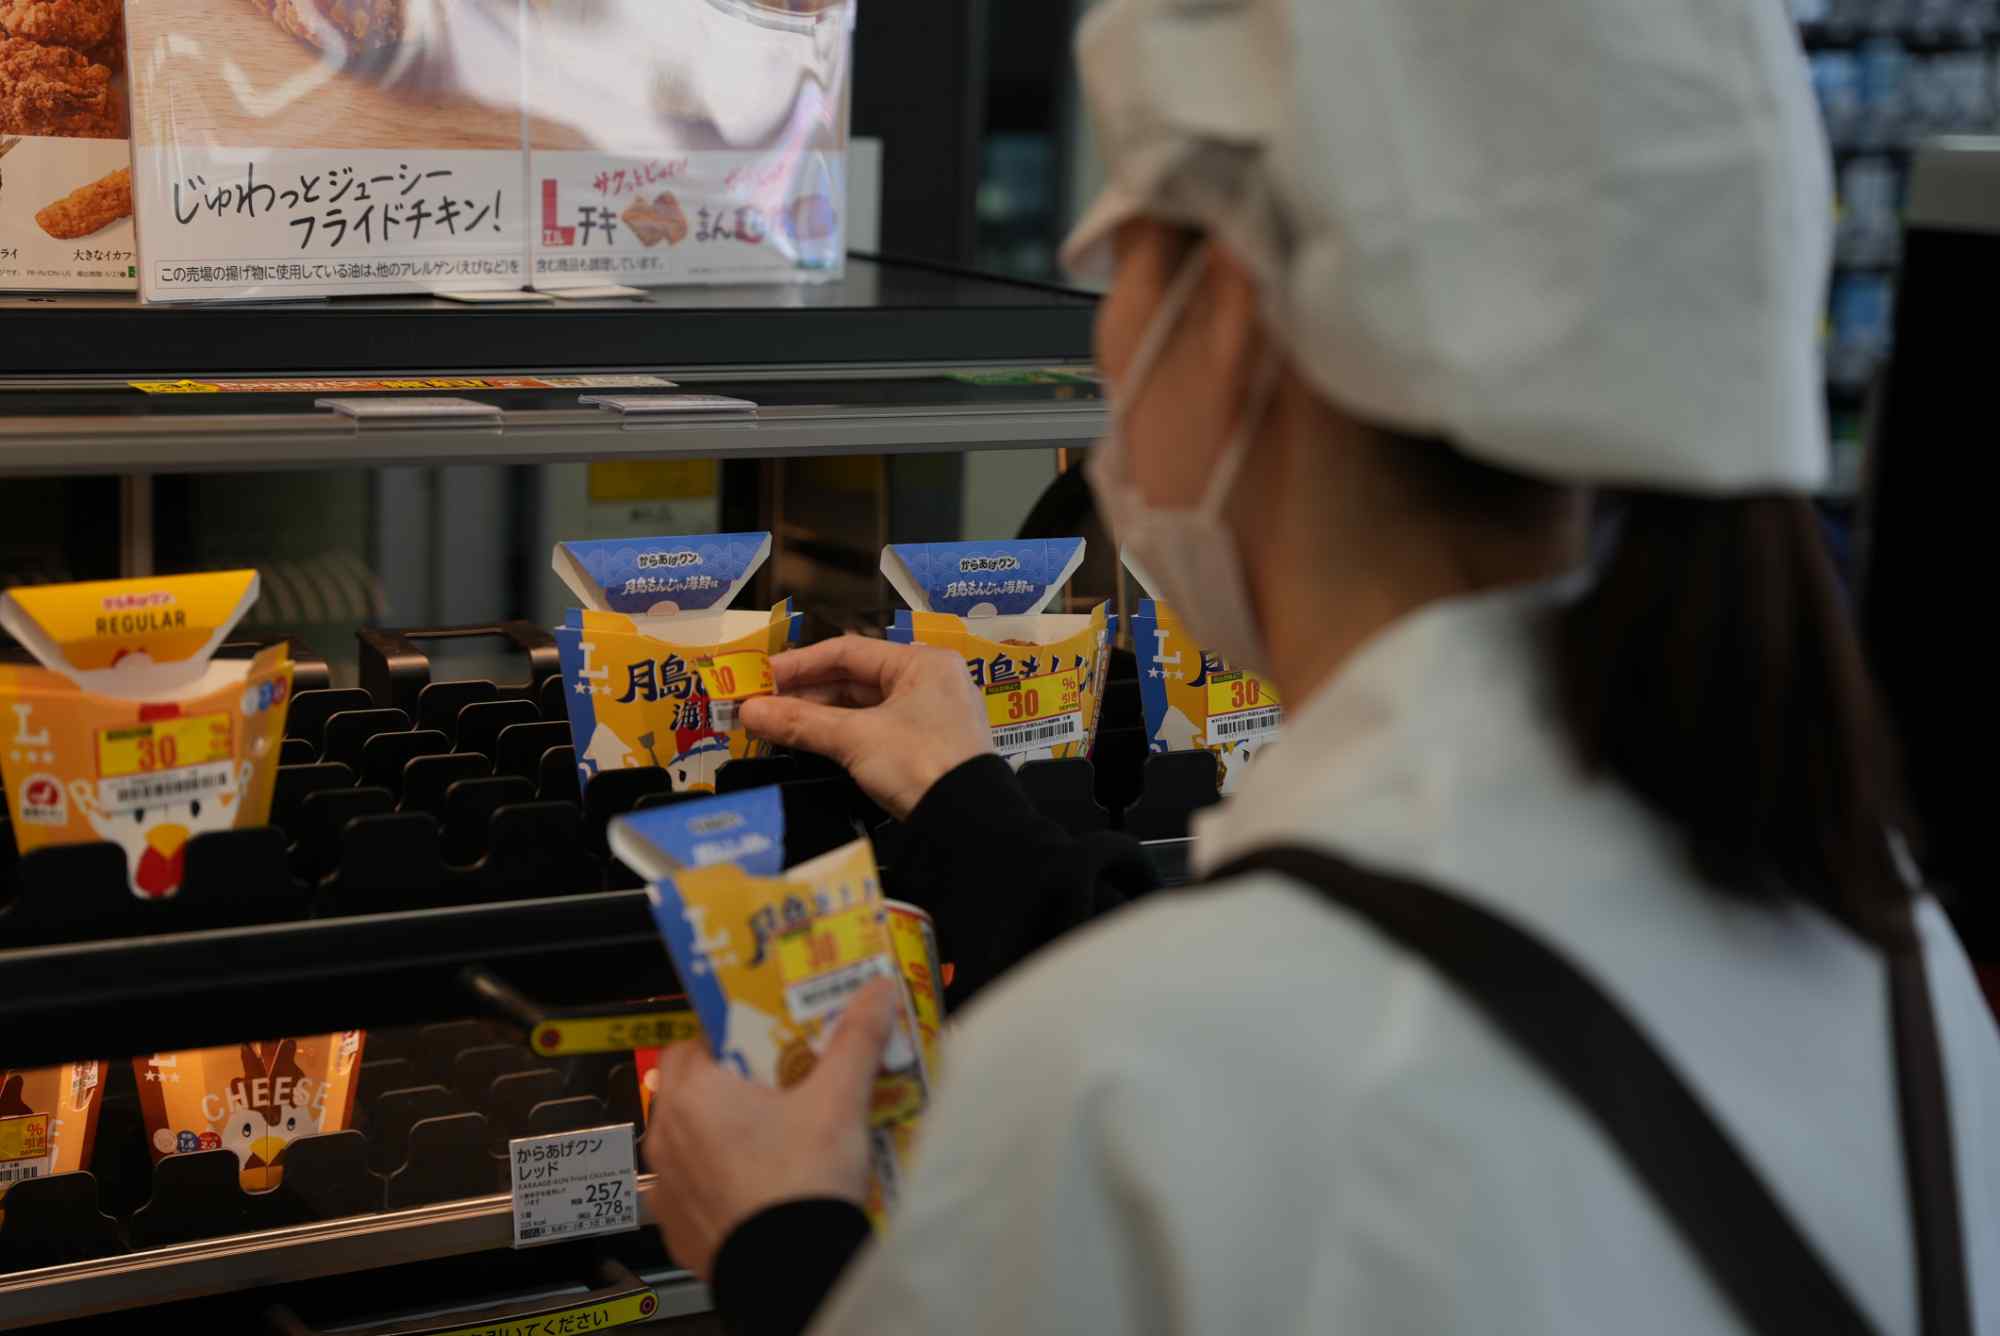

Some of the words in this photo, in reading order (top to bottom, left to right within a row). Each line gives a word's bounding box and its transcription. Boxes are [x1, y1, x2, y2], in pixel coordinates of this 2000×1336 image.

[173, 162, 453, 225] じゅわっとジューシー
[290, 189, 502, 249] フライドチキン!
[73, 248, 136, 262] 大きなイカフ
[96, 610, 187, 634] REGULAR
[578, 642, 609, 679] L
[1152, 629, 1182, 665] L
[1008, 689, 1039, 719] 30
[1231, 679, 1260, 708] 30
[12, 703, 49, 744] L
[137, 735, 177, 772] 30
[202, 1076, 332, 1123] CHEESE
[517, 1138, 603, 1164] からあげクン
[519, 1162, 559, 1181] レッド
[585, 1180, 623, 1203] 257
[594, 1200, 623, 1217] 278
